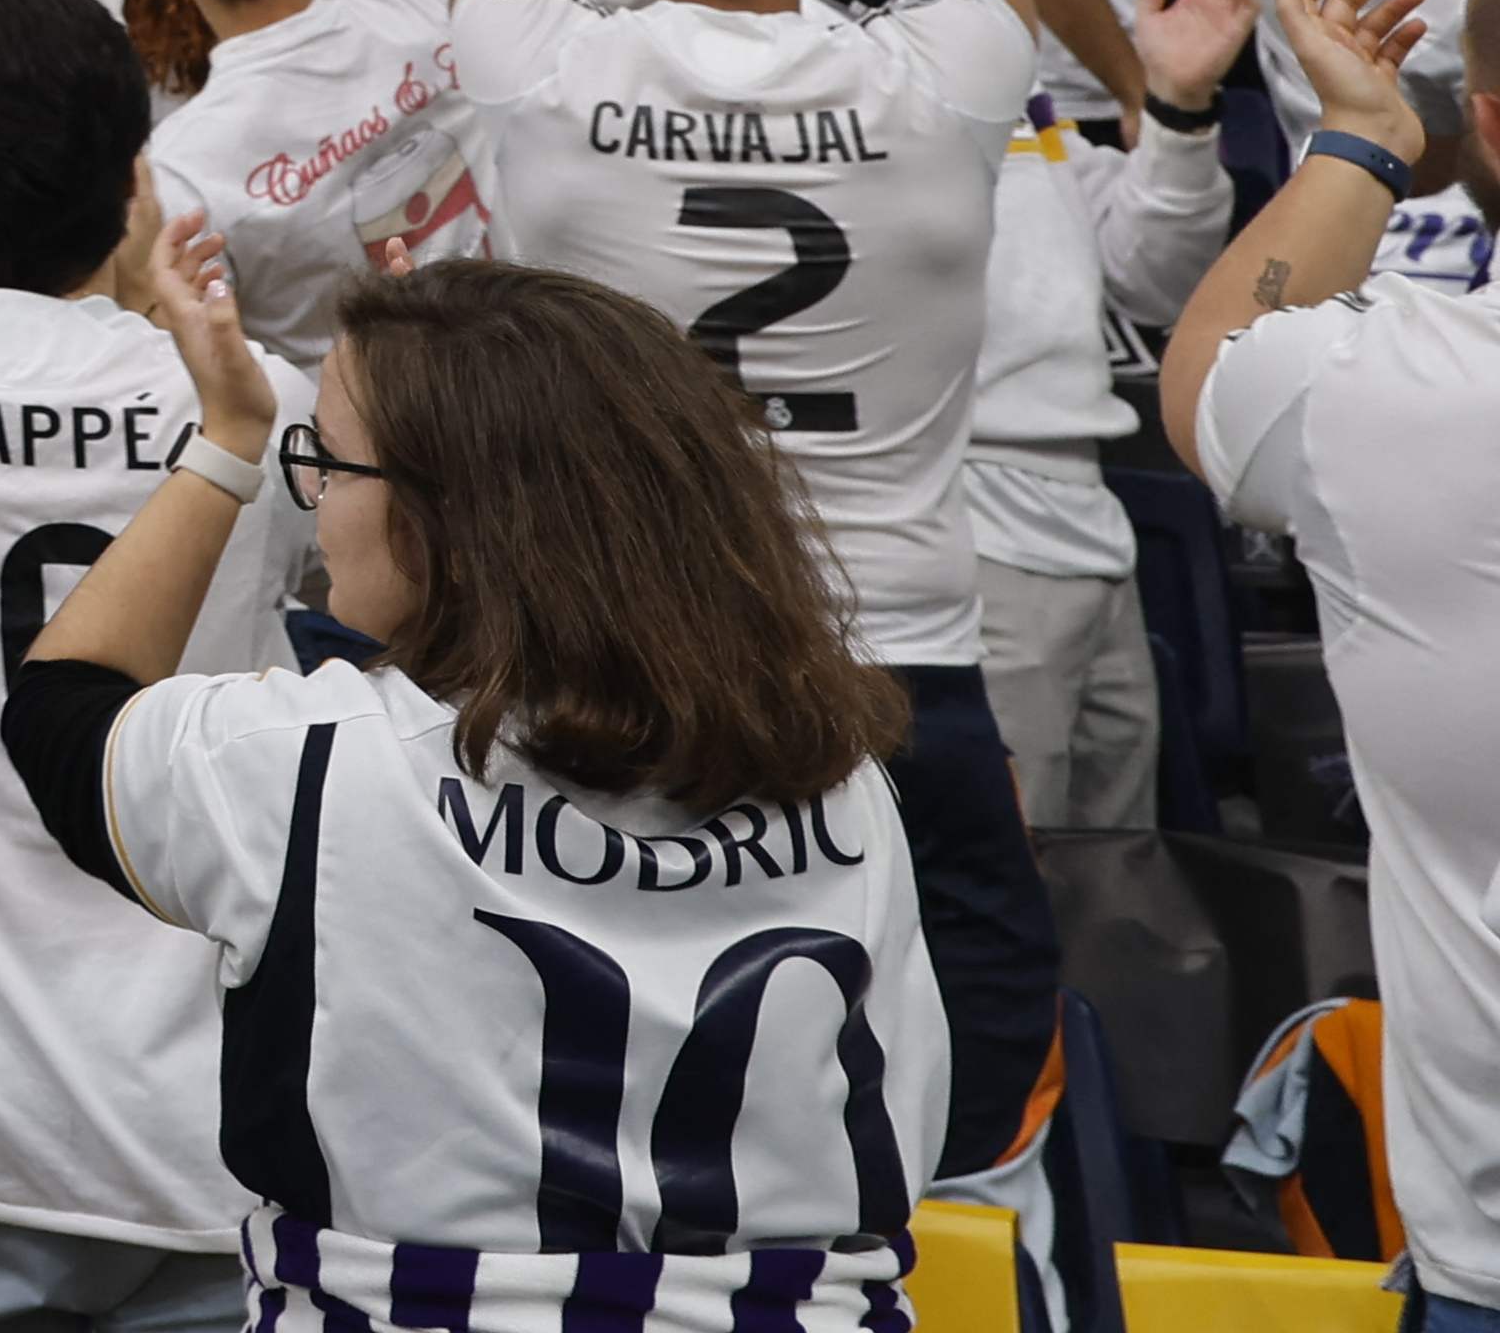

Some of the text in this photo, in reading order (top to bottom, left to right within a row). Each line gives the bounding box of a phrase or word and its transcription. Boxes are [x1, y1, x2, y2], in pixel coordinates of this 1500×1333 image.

[589, 100, 889, 164] CARVAJAL
[677, 186, 859, 431] 2
[437, 776, 866, 893] MODRIC
[472, 907, 911, 1255] 10
